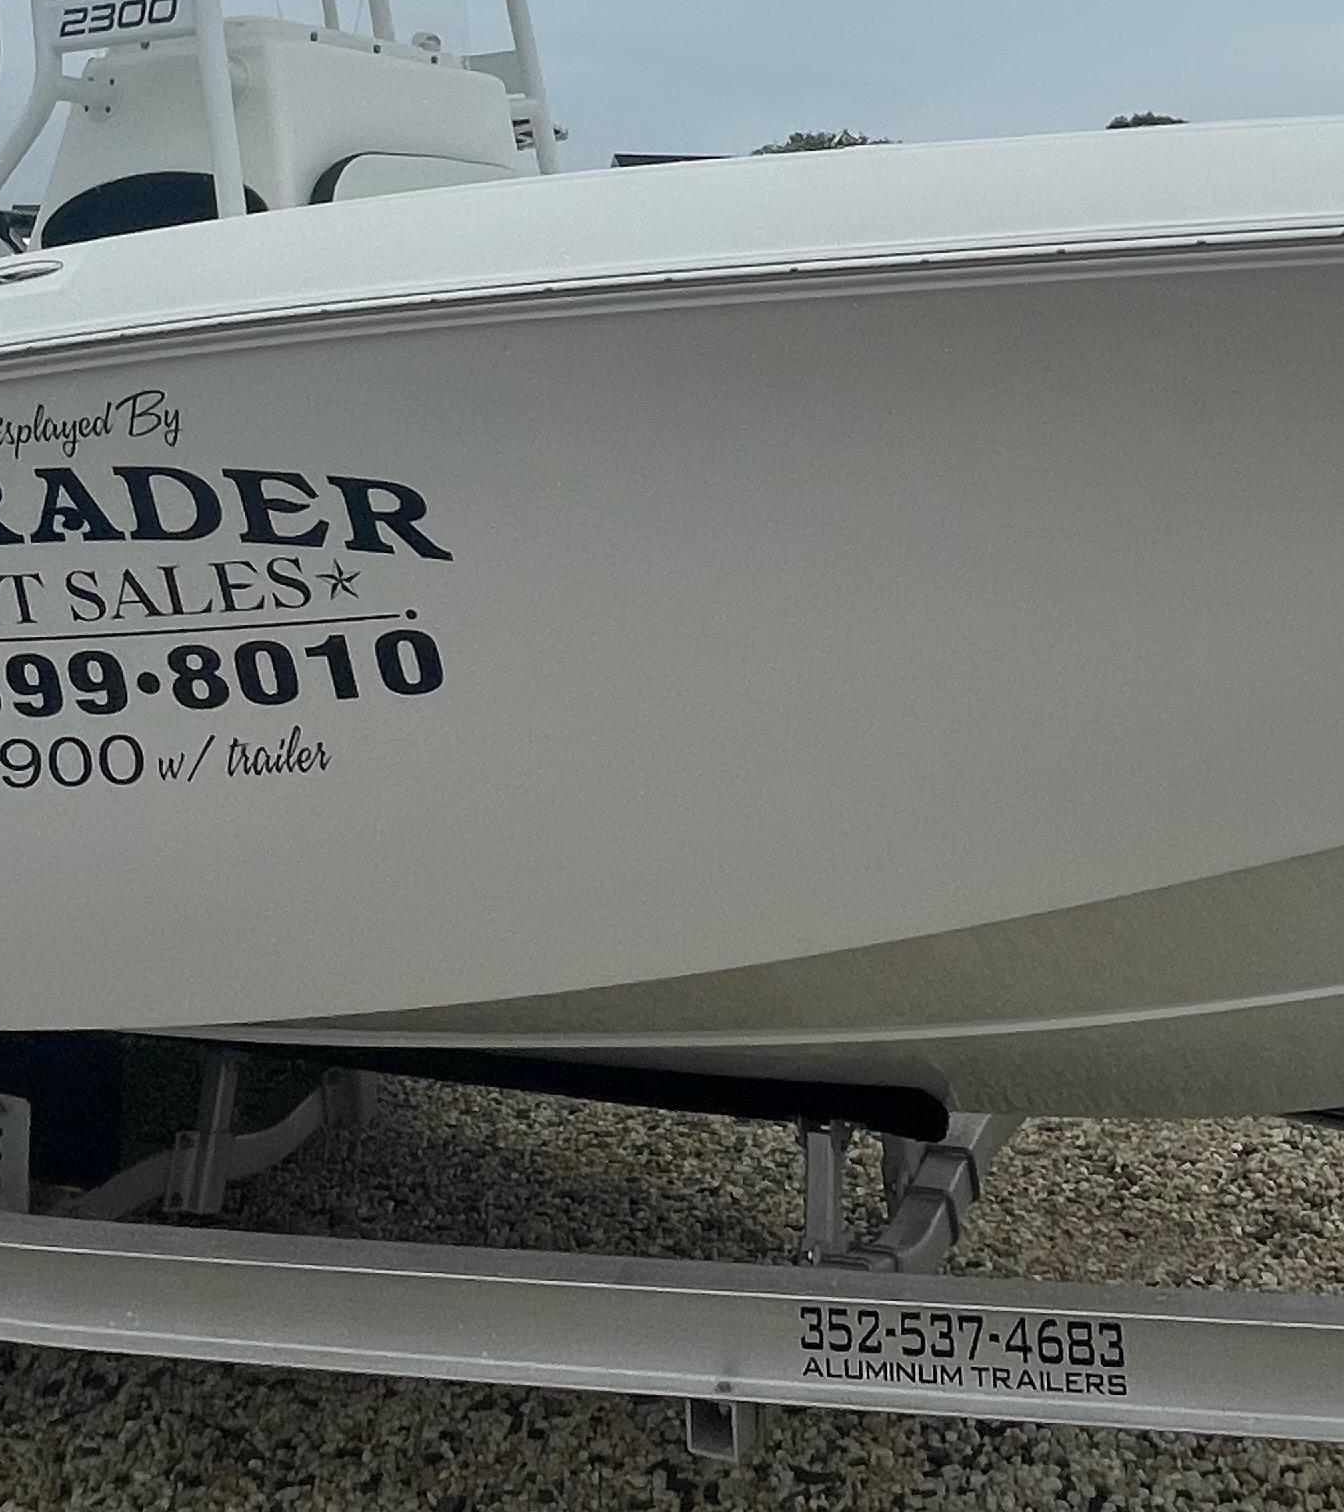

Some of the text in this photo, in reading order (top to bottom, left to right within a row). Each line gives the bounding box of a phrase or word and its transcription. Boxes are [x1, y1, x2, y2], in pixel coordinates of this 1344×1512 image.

[114, 389, 181, 448] By
[65, 555, 313, 623] SALES
[157, 734, 216, 783] w/
[226, 724, 333, 779] trailer
[799, 1306, 1126, 1369] 352-537-4683
[802, 1356, 1128, 1396] ALUMINUM TRAILERS
